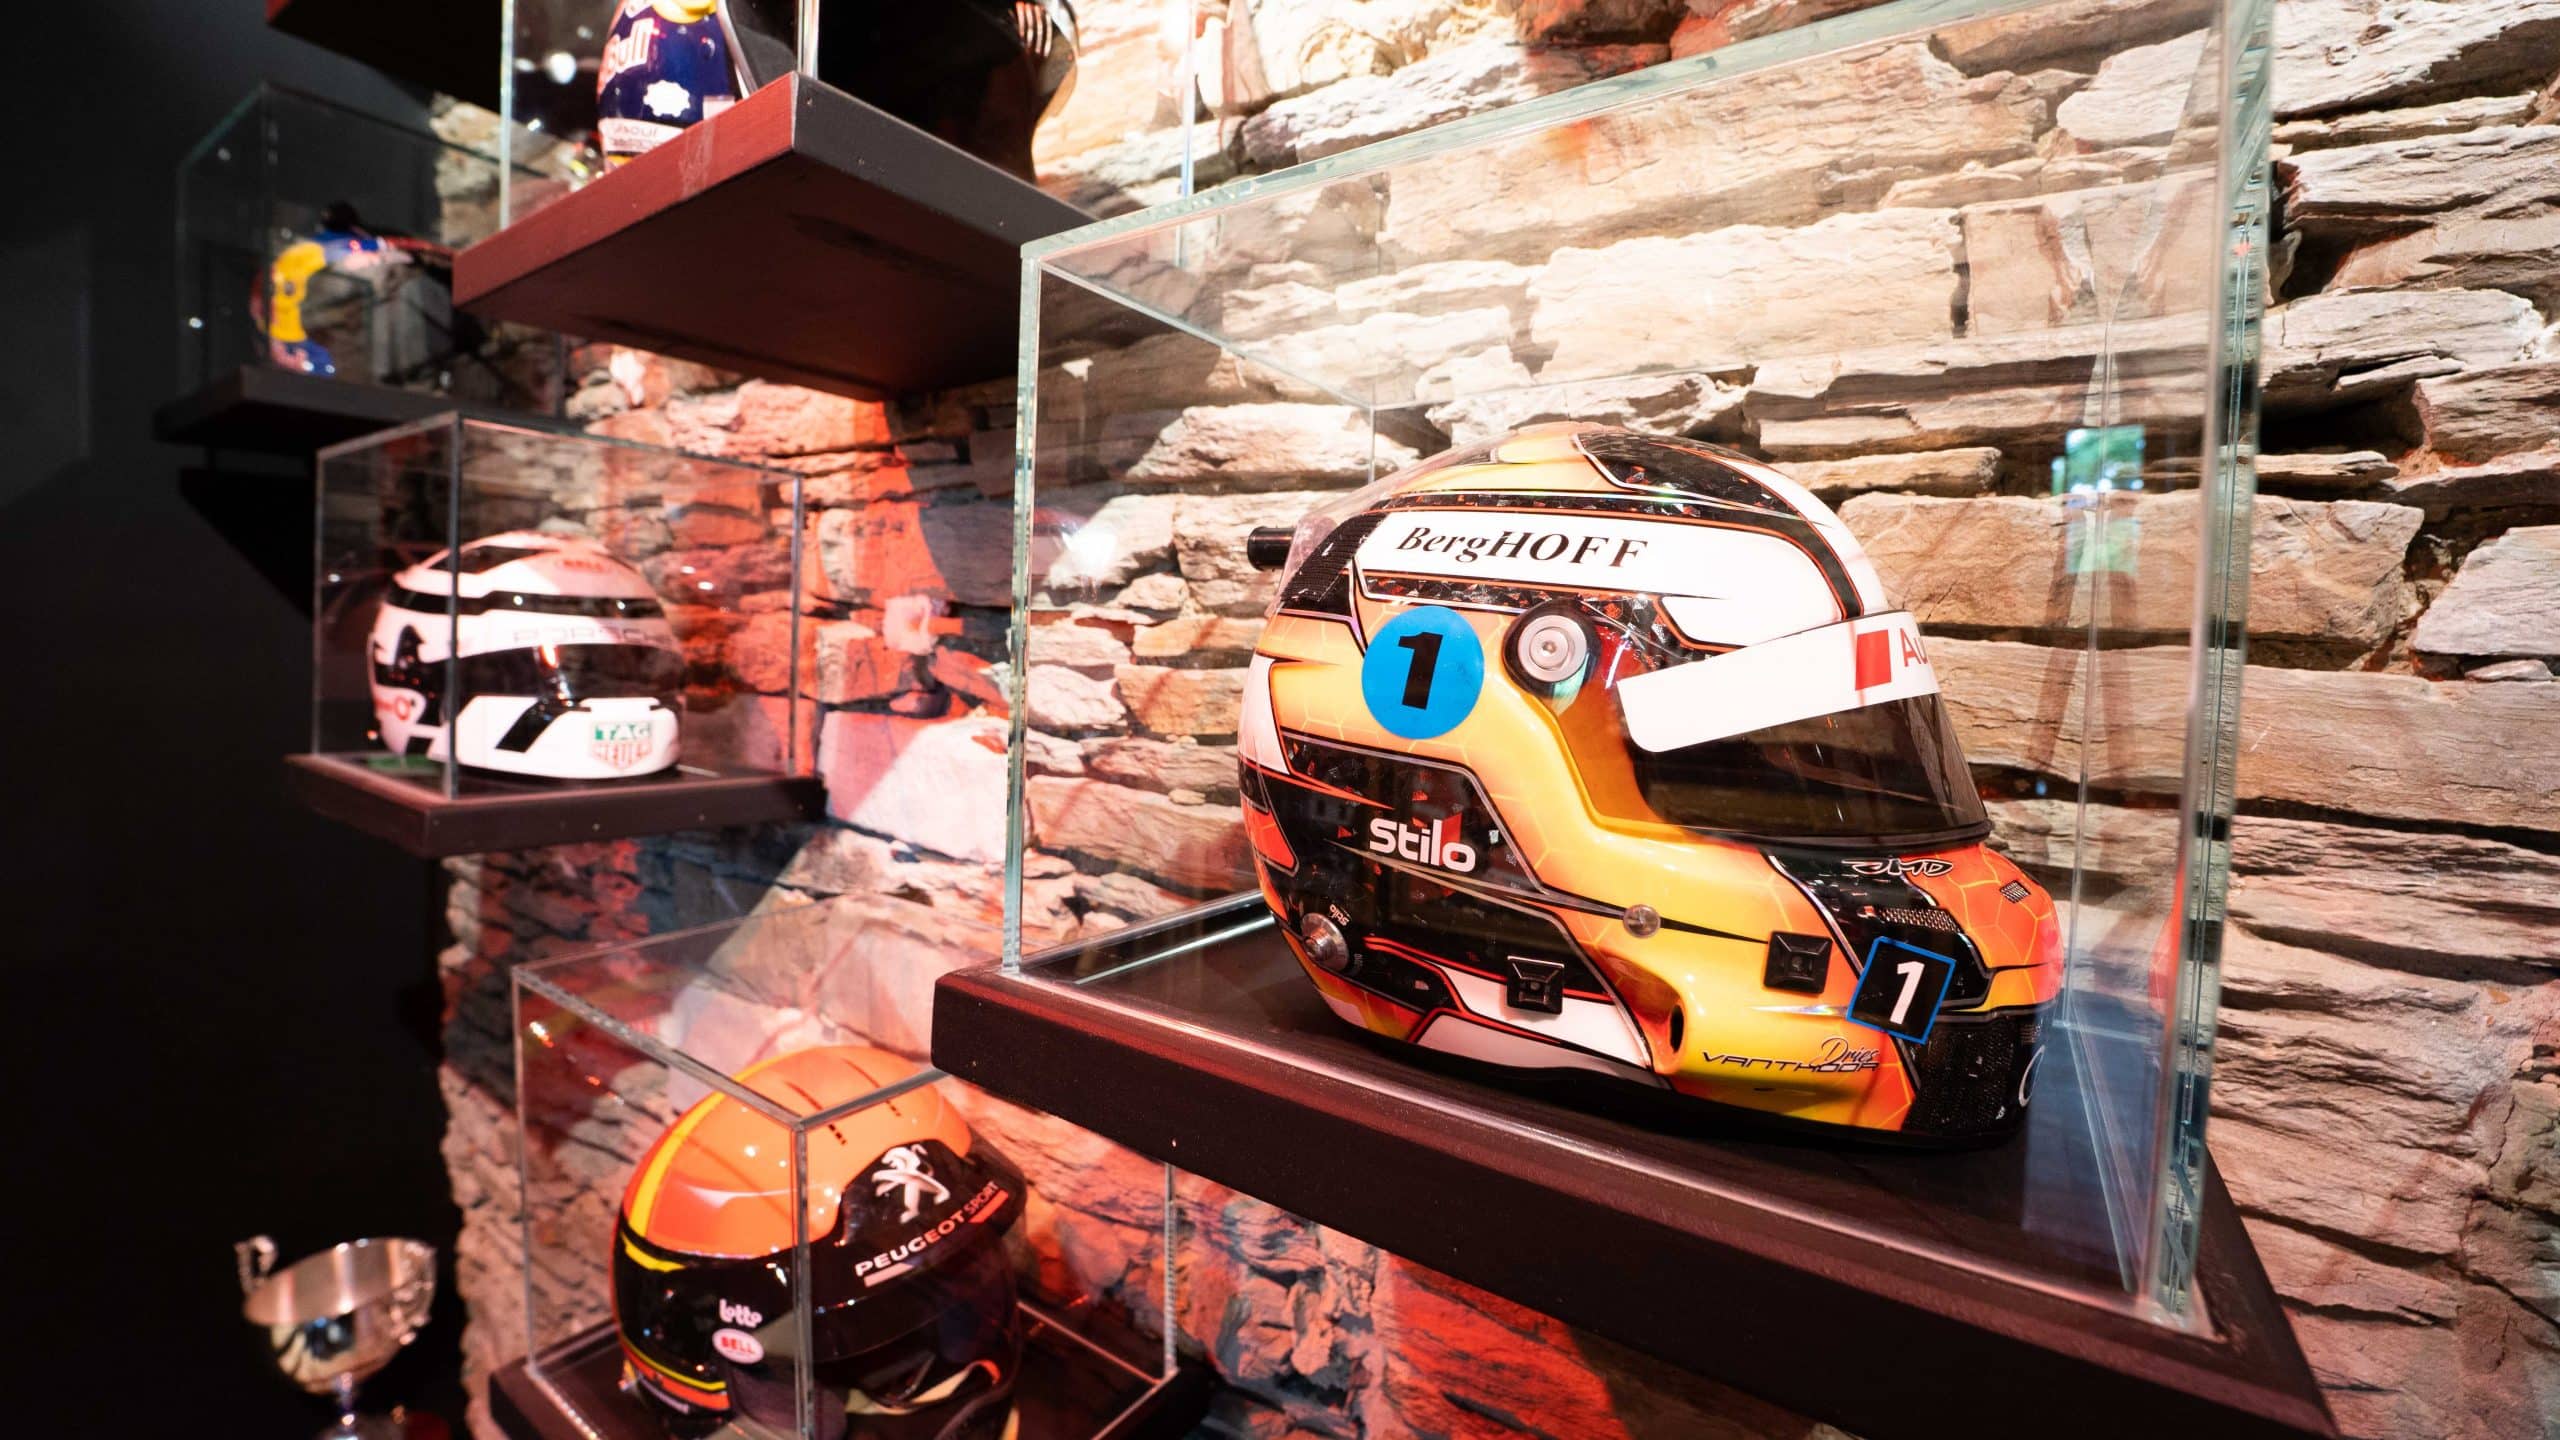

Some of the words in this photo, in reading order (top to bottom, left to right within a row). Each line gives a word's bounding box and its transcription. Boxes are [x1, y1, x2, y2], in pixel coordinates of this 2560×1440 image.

[1396, 526, 1649, 568] BergHOFF
[1398, 630, 1444, 710] 1
[1369, 818, 1476, 872] stilo
[1889, 960, 1925, 1025] 1
[854, 1210, 966, 1277] PEUGEOT
[964, 1180, 1000, 1215] SPORT
[720, 1336, 756, 1355] BELL
